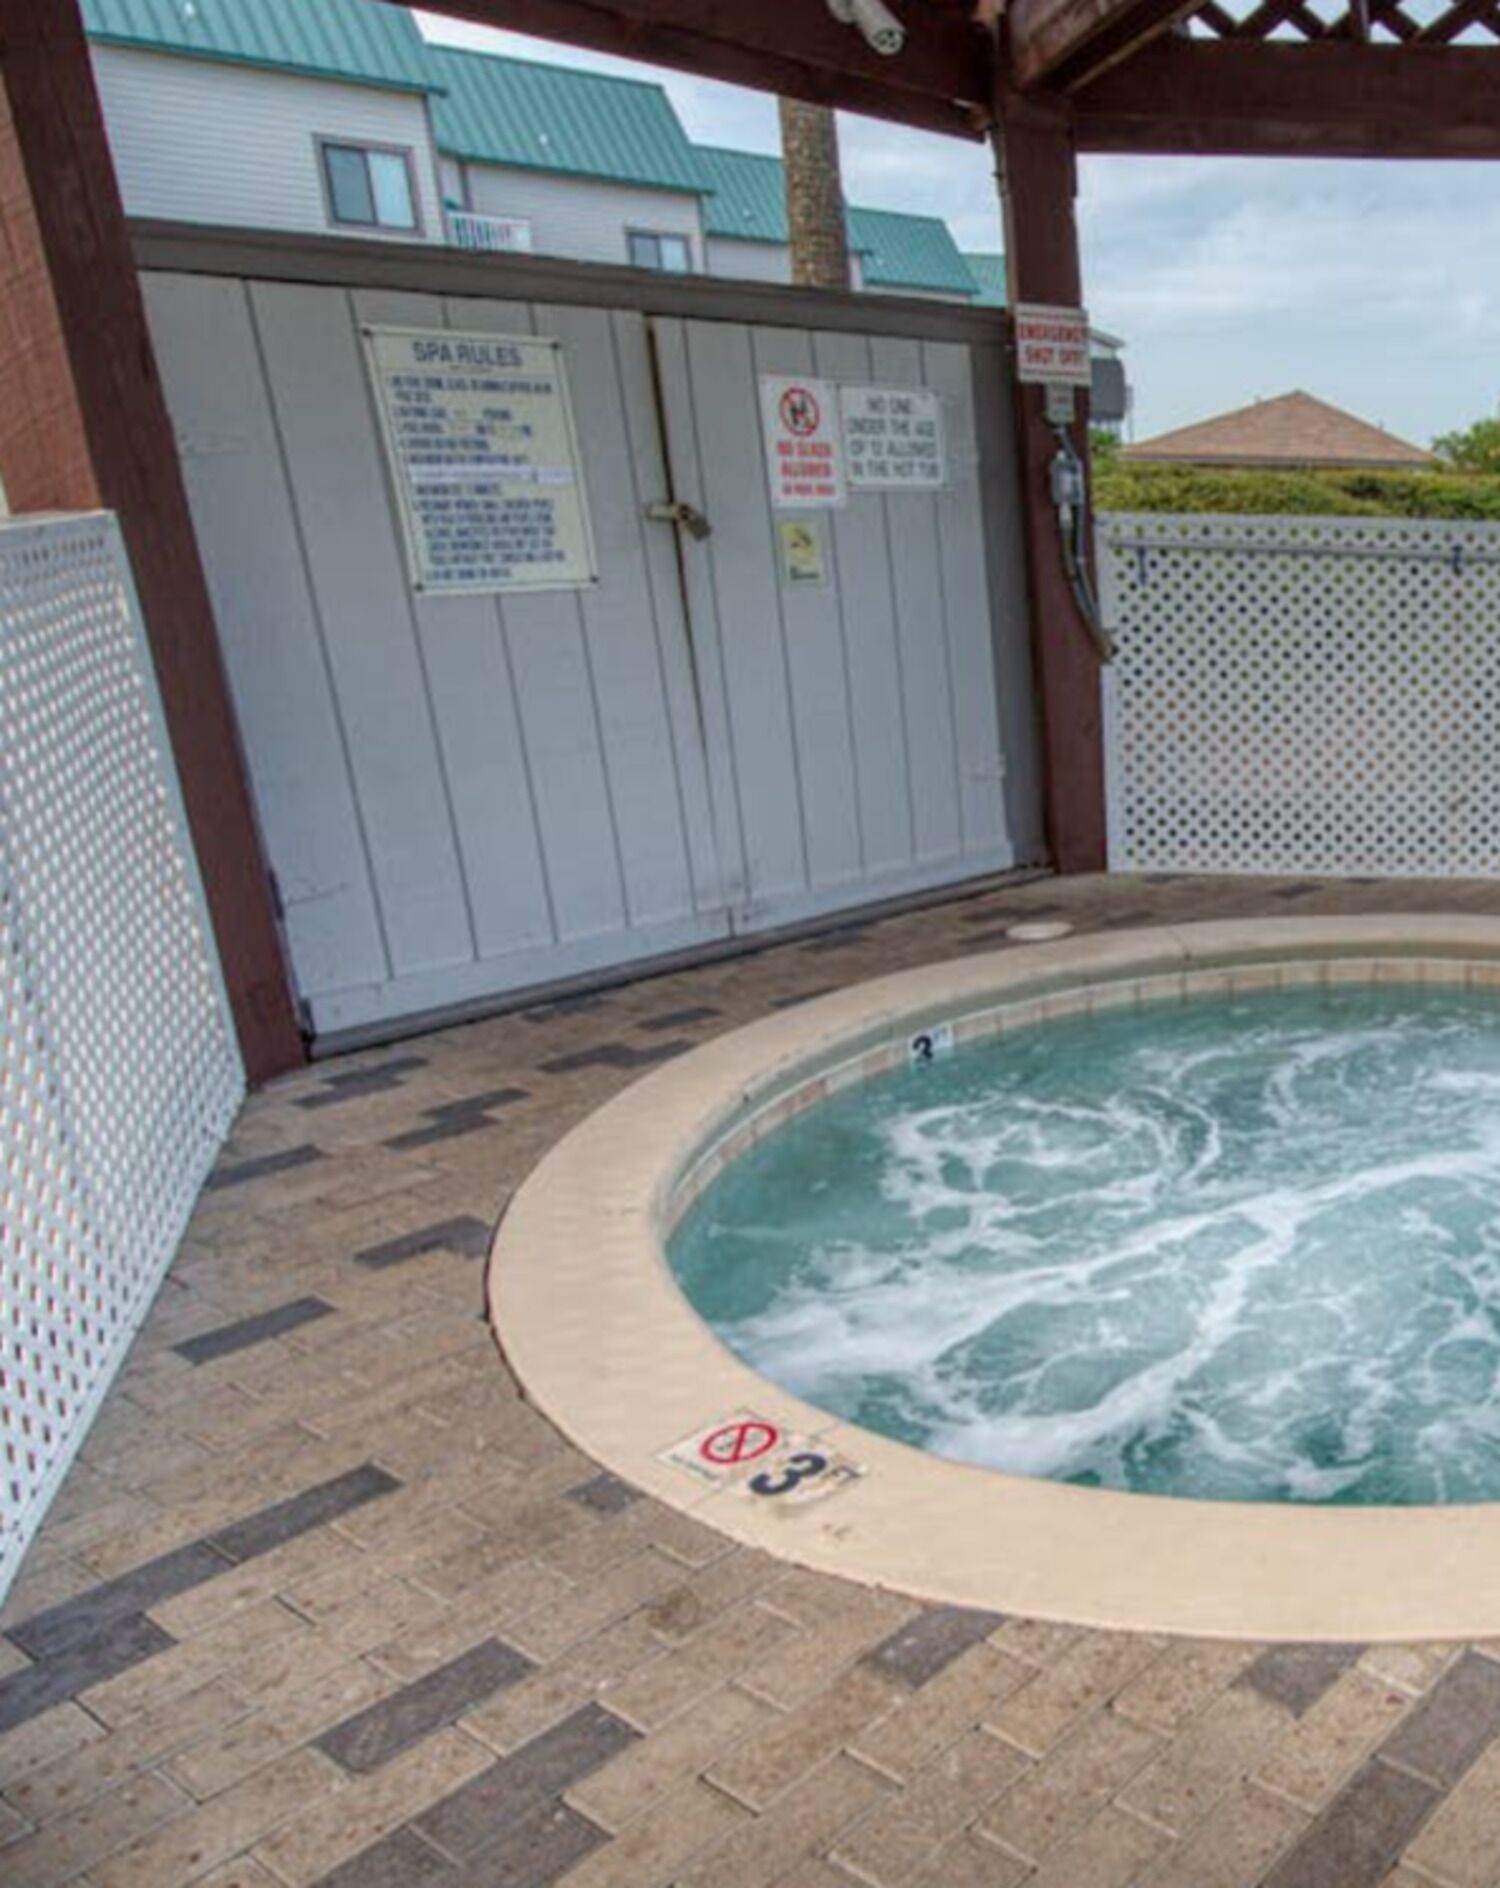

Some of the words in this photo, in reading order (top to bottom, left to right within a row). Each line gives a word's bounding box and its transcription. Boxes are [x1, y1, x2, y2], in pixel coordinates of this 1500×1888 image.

[413, 341, 452, 362] SPA
[456, 343, 523, 367] RULES
[1025, 345, 1054, 364] SHUT
[868, 397, 885, 413] NO
[889, 398, 911, 415] ONE
[849, 417, 886, 434] UNDER
[891, 419, 910, 436] THE
[915, 421, 936, 438] AGE
[776, 441, 793, 457] NO
[797, 441, 832, 457] GLASS
[851, 440, 865, 456] OF
[871, 441, 882, 456] 12
[887, 441, 937, 458] ALLOWED
[781, 462, 832, 477] ALLOWED
[852, 462, 864, 478] IN
[867, 460, 889, 477] THE
[893, 461, 915, 478] HOT
[918, 461, 940, 479] TUB
[749, 1453, 827, 1496] 3
